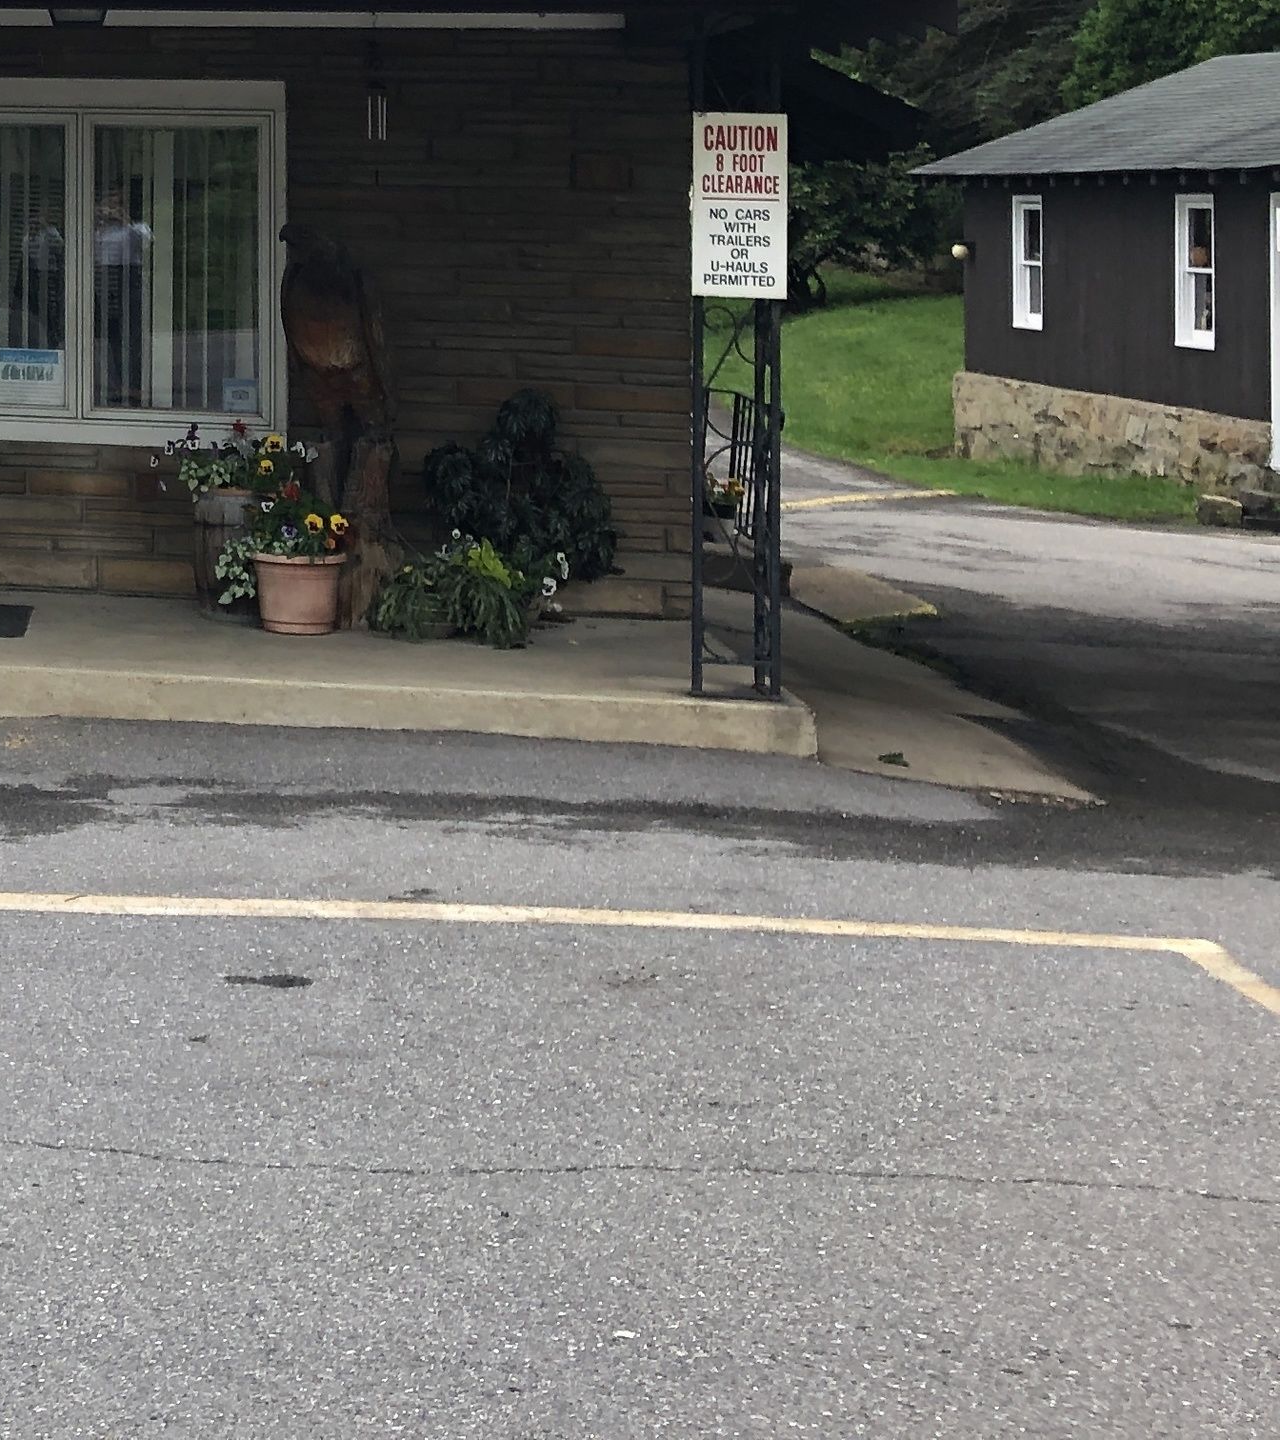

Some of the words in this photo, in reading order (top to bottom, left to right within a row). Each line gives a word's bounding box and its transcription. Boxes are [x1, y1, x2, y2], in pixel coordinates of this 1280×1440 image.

[703, 124, 778, 152] CAUTION
[716, 153, 724, 172] 8
[732, 154, 765, 172] FOOT
[702, 174, 780, 195] CLEARANCE
[709, 208, 728, 220] NO
[735, 209, 770, 221] CARS
[724, 222, 756, 233] WITH
[709, 234, 771, 247] TRAILERS
[730, 248, 749, 259] OR
[711, 261, 768, 273] U-HAULS
[703, 274, 775, 287] PERMITTED
